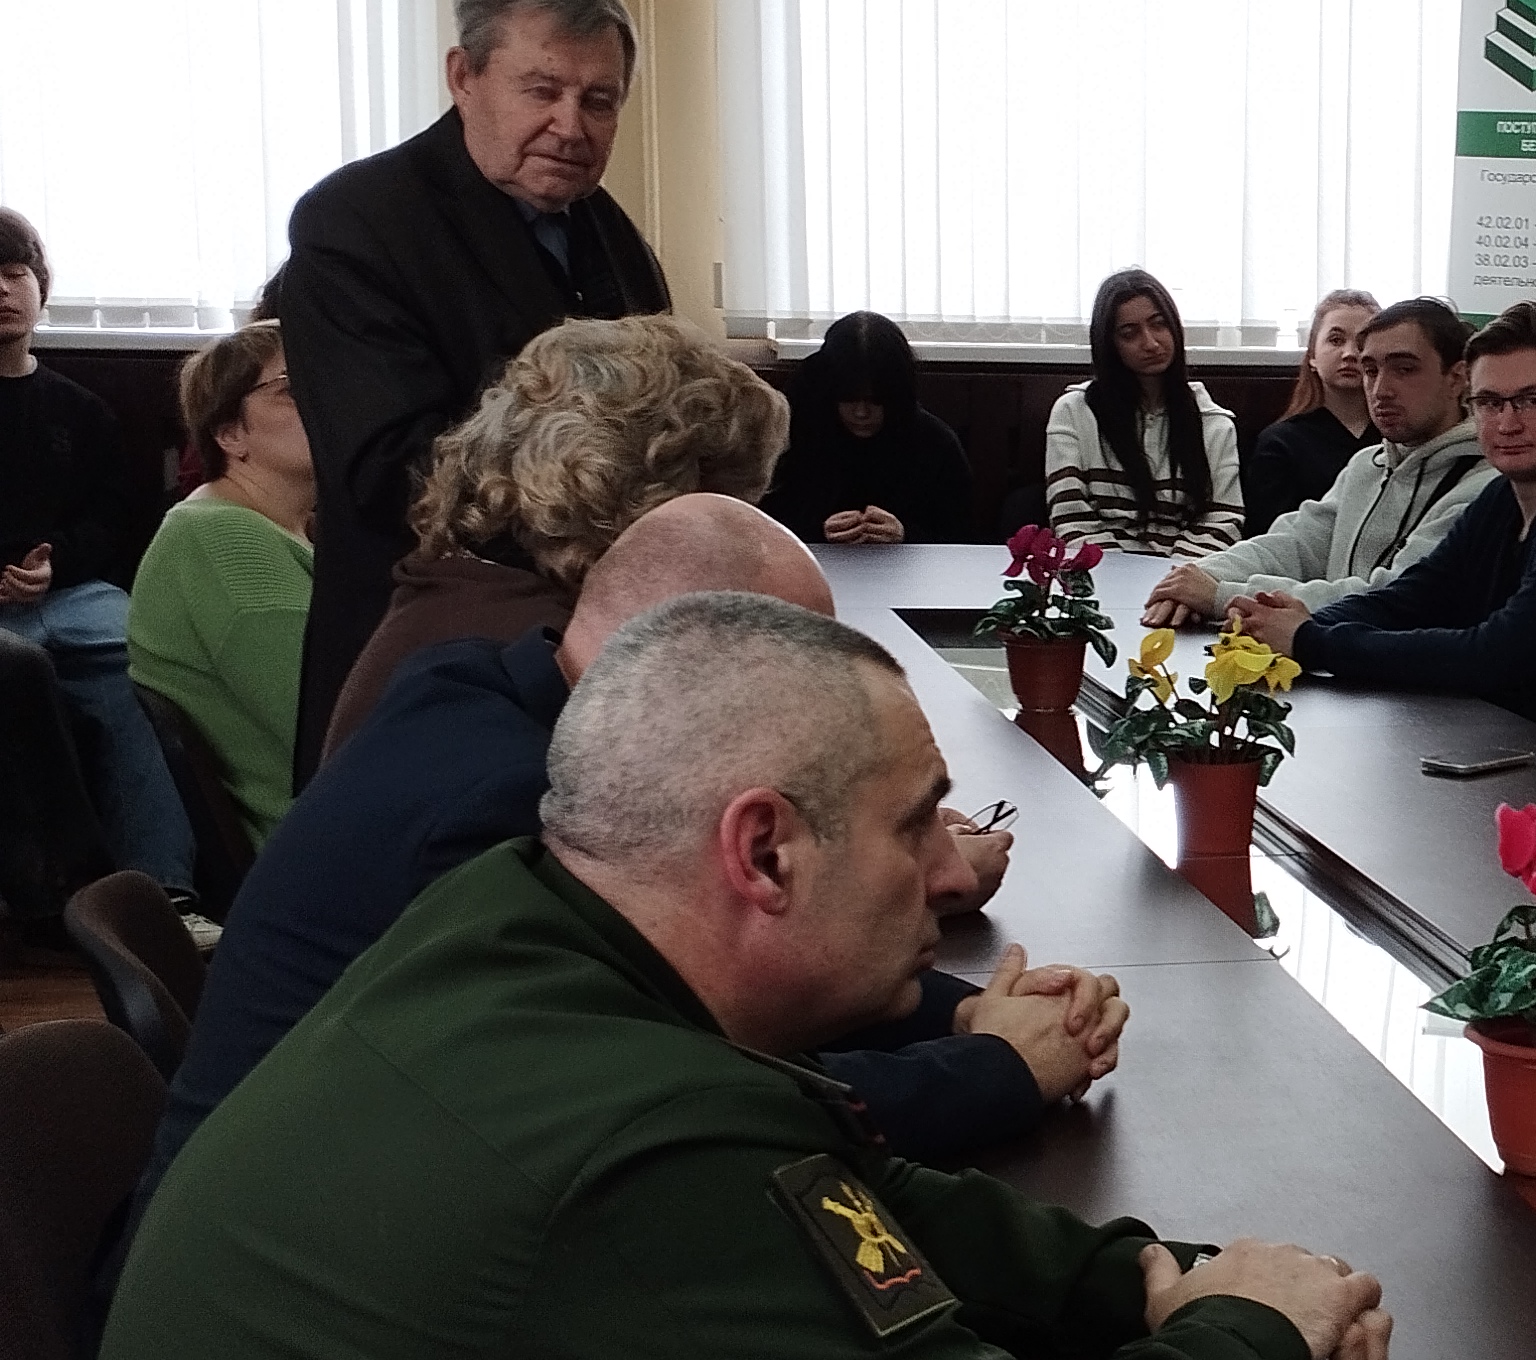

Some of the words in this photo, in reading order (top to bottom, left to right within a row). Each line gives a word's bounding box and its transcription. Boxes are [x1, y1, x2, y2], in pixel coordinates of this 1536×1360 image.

[1476, 216, 1529, 230] 42.02.01
[1475, 235, 1529, 249] 40.02.04
[1474, 253, 1529, 268] 38.02.03
